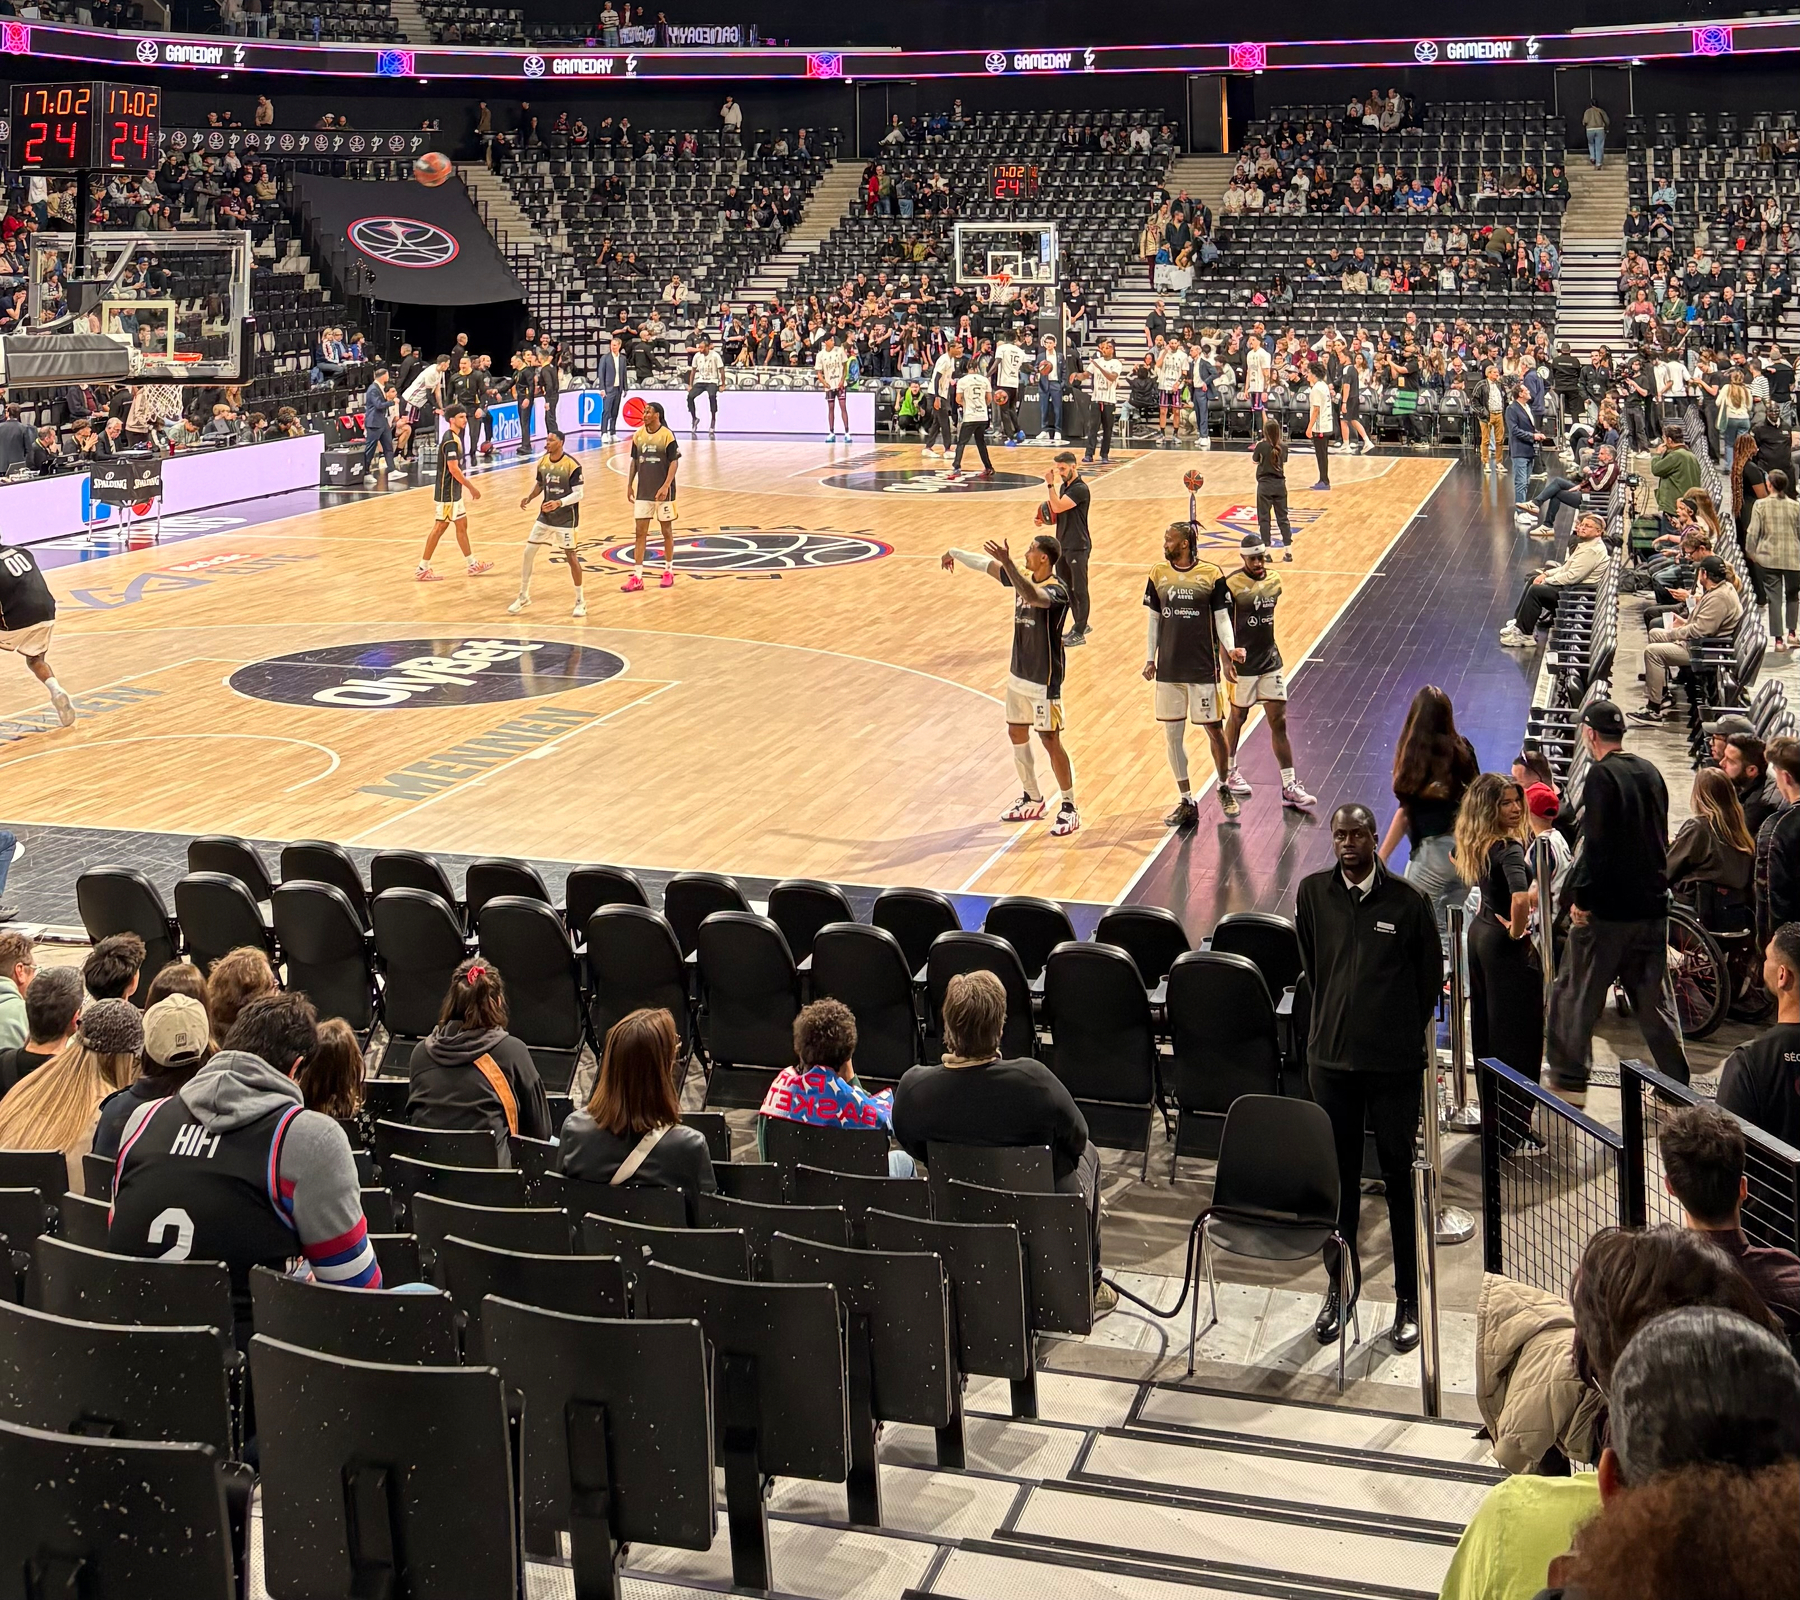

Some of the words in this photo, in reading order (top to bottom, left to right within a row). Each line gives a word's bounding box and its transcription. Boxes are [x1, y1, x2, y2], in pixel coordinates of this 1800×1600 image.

[165, 44, 223, 64] GAMEDAY
[1013, 52, 1072, 70] GAMEDAY
[1446, 41, 1512, 59] GAMEDAY
[552, 58, 613, 75] GAMEDAY
[23, 88, 90, 115] 17:02
[109, 90, 158, 118] 17:02
[25, 121, 77, 162] 24
[111, 121, 149, 161] 24
[994, 166, 1025, 178] 17:02
[995, 179, 1020, 196] 24
[93, 478, 128, 490] SPALDING
[133, 475, 160, 489] SPALDING
[3, 552, 33, 577] 00
[313, 640, 545, 706] OlyBet
[356, 706, 600, 801] MENNEN
[169, 1123, 222, 1159] HIFI
